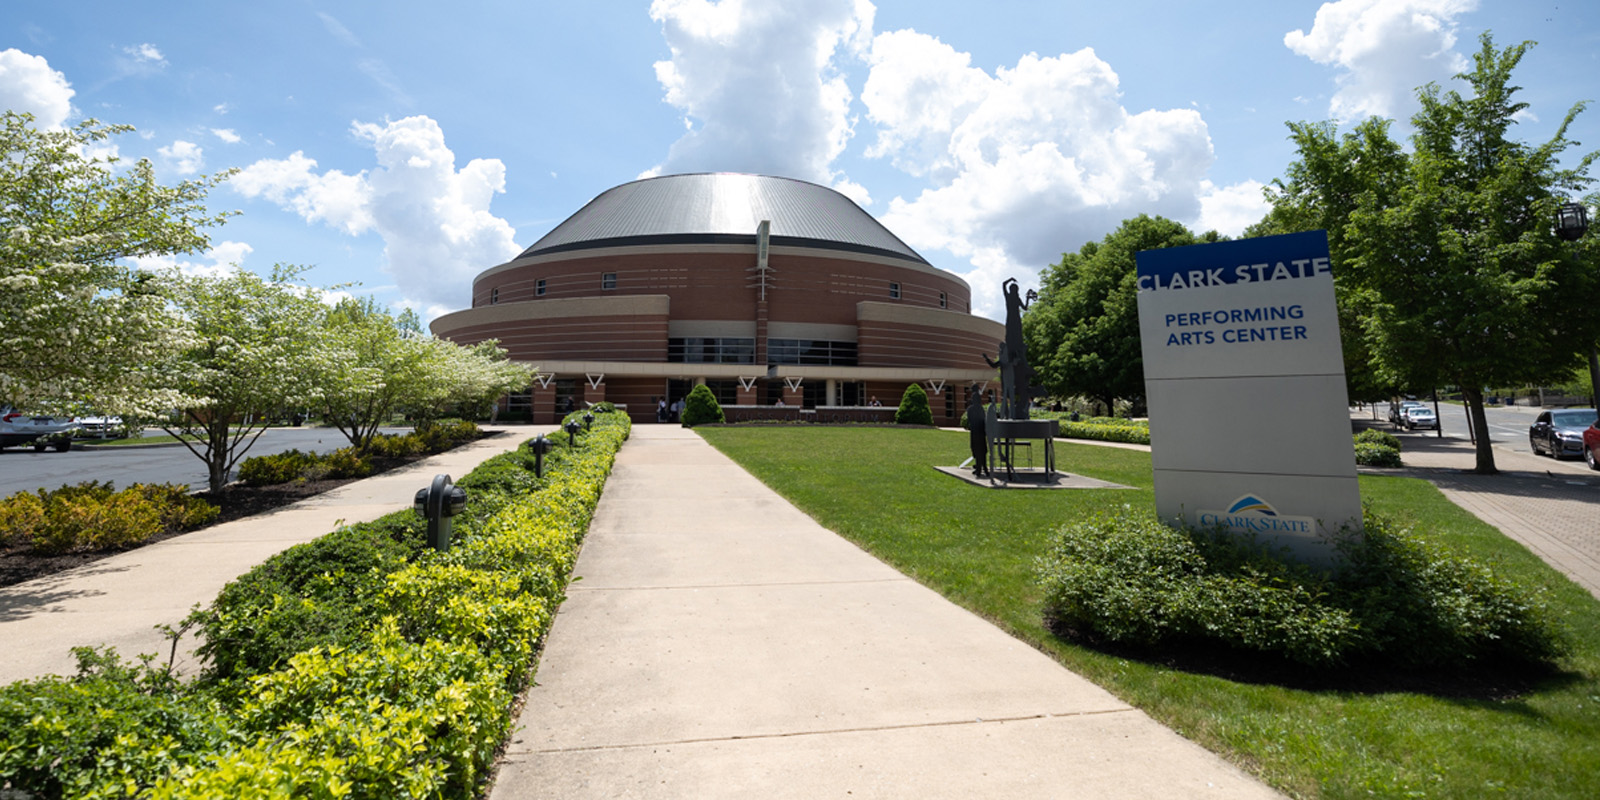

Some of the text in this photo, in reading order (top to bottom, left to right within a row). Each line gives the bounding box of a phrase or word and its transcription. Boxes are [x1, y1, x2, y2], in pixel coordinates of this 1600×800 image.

[1136, 257, 1329, 293] CLARK STATE
[1165, 304, 1304, 327] PERFORMING
[1166, 325, 1307, 347] ARTS CENTER
[1259, 517, 1310, 532] STATE
